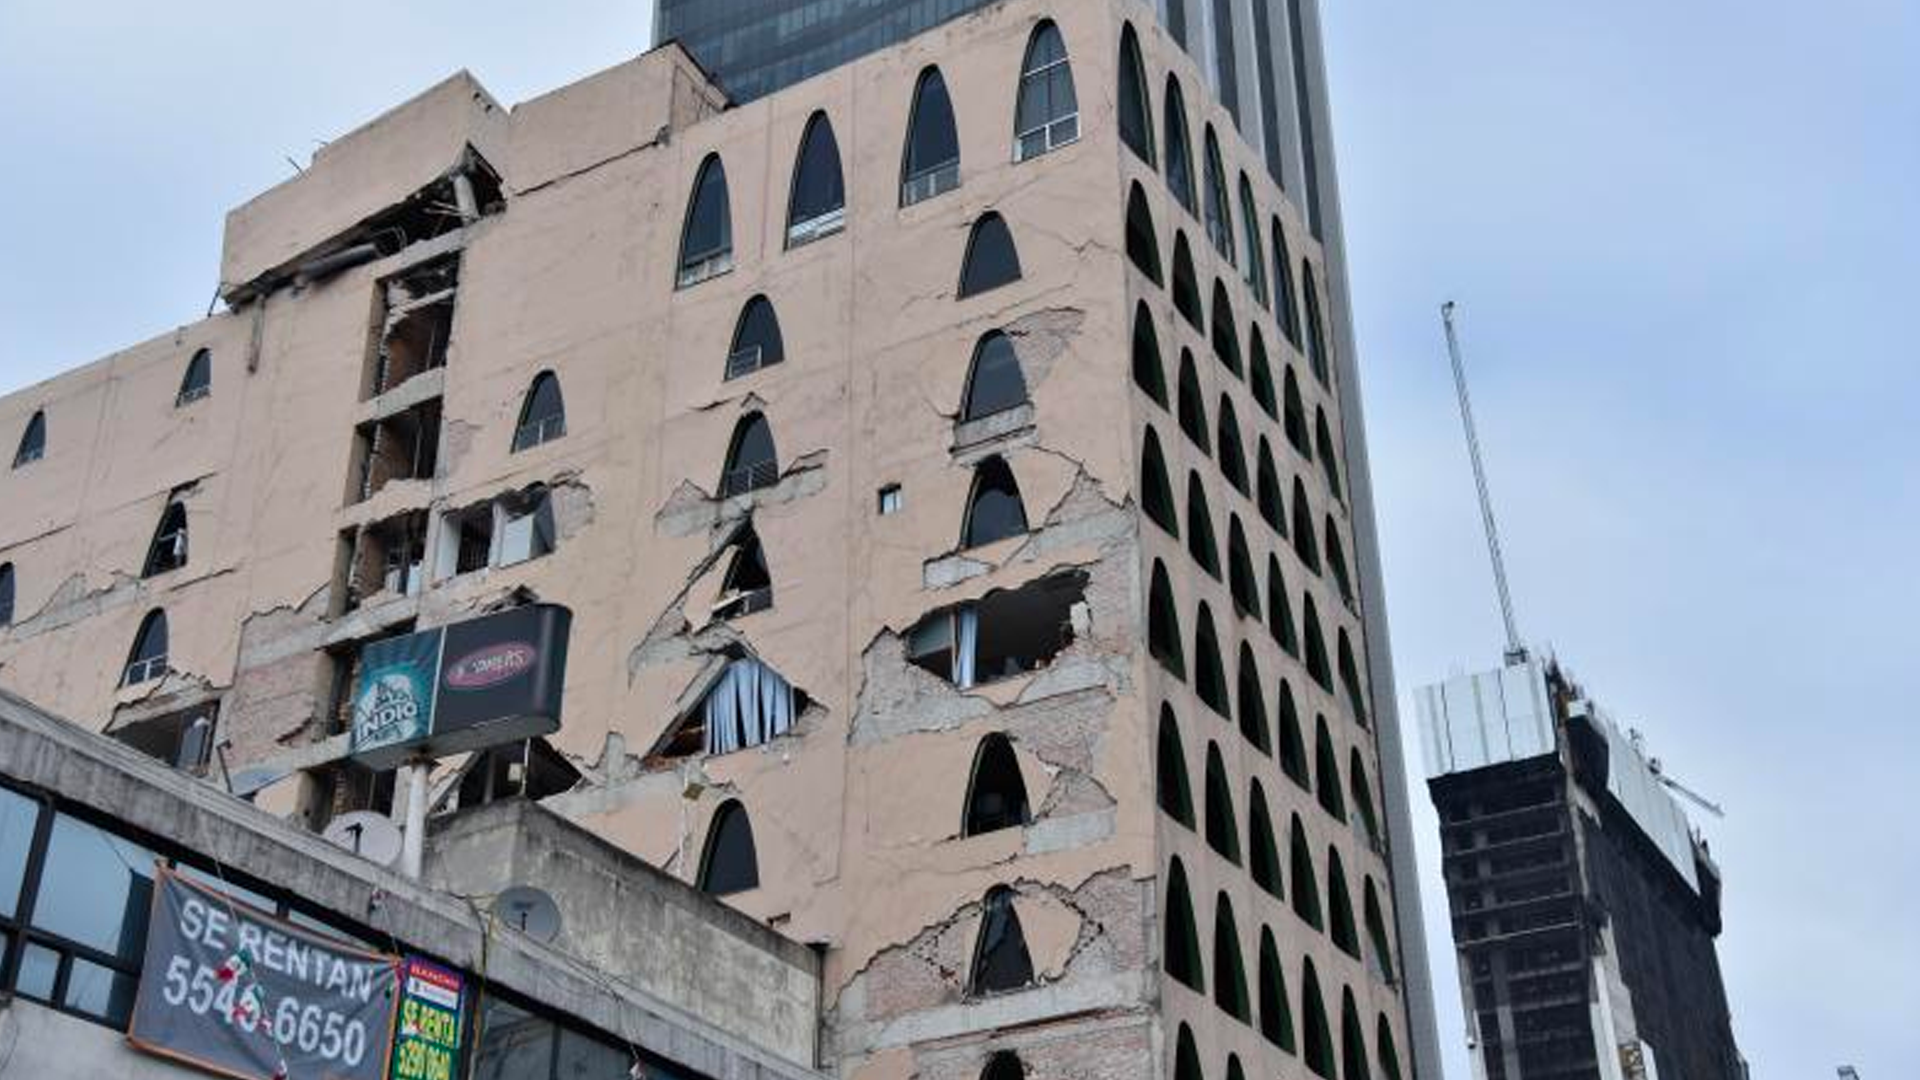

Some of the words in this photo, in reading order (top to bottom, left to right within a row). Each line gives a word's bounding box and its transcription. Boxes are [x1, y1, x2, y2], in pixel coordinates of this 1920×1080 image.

[355, 701, 418, 743] INDIO
[179, 899, 228, 950] SE
[238, 923, 373, 1002] RENTAN
